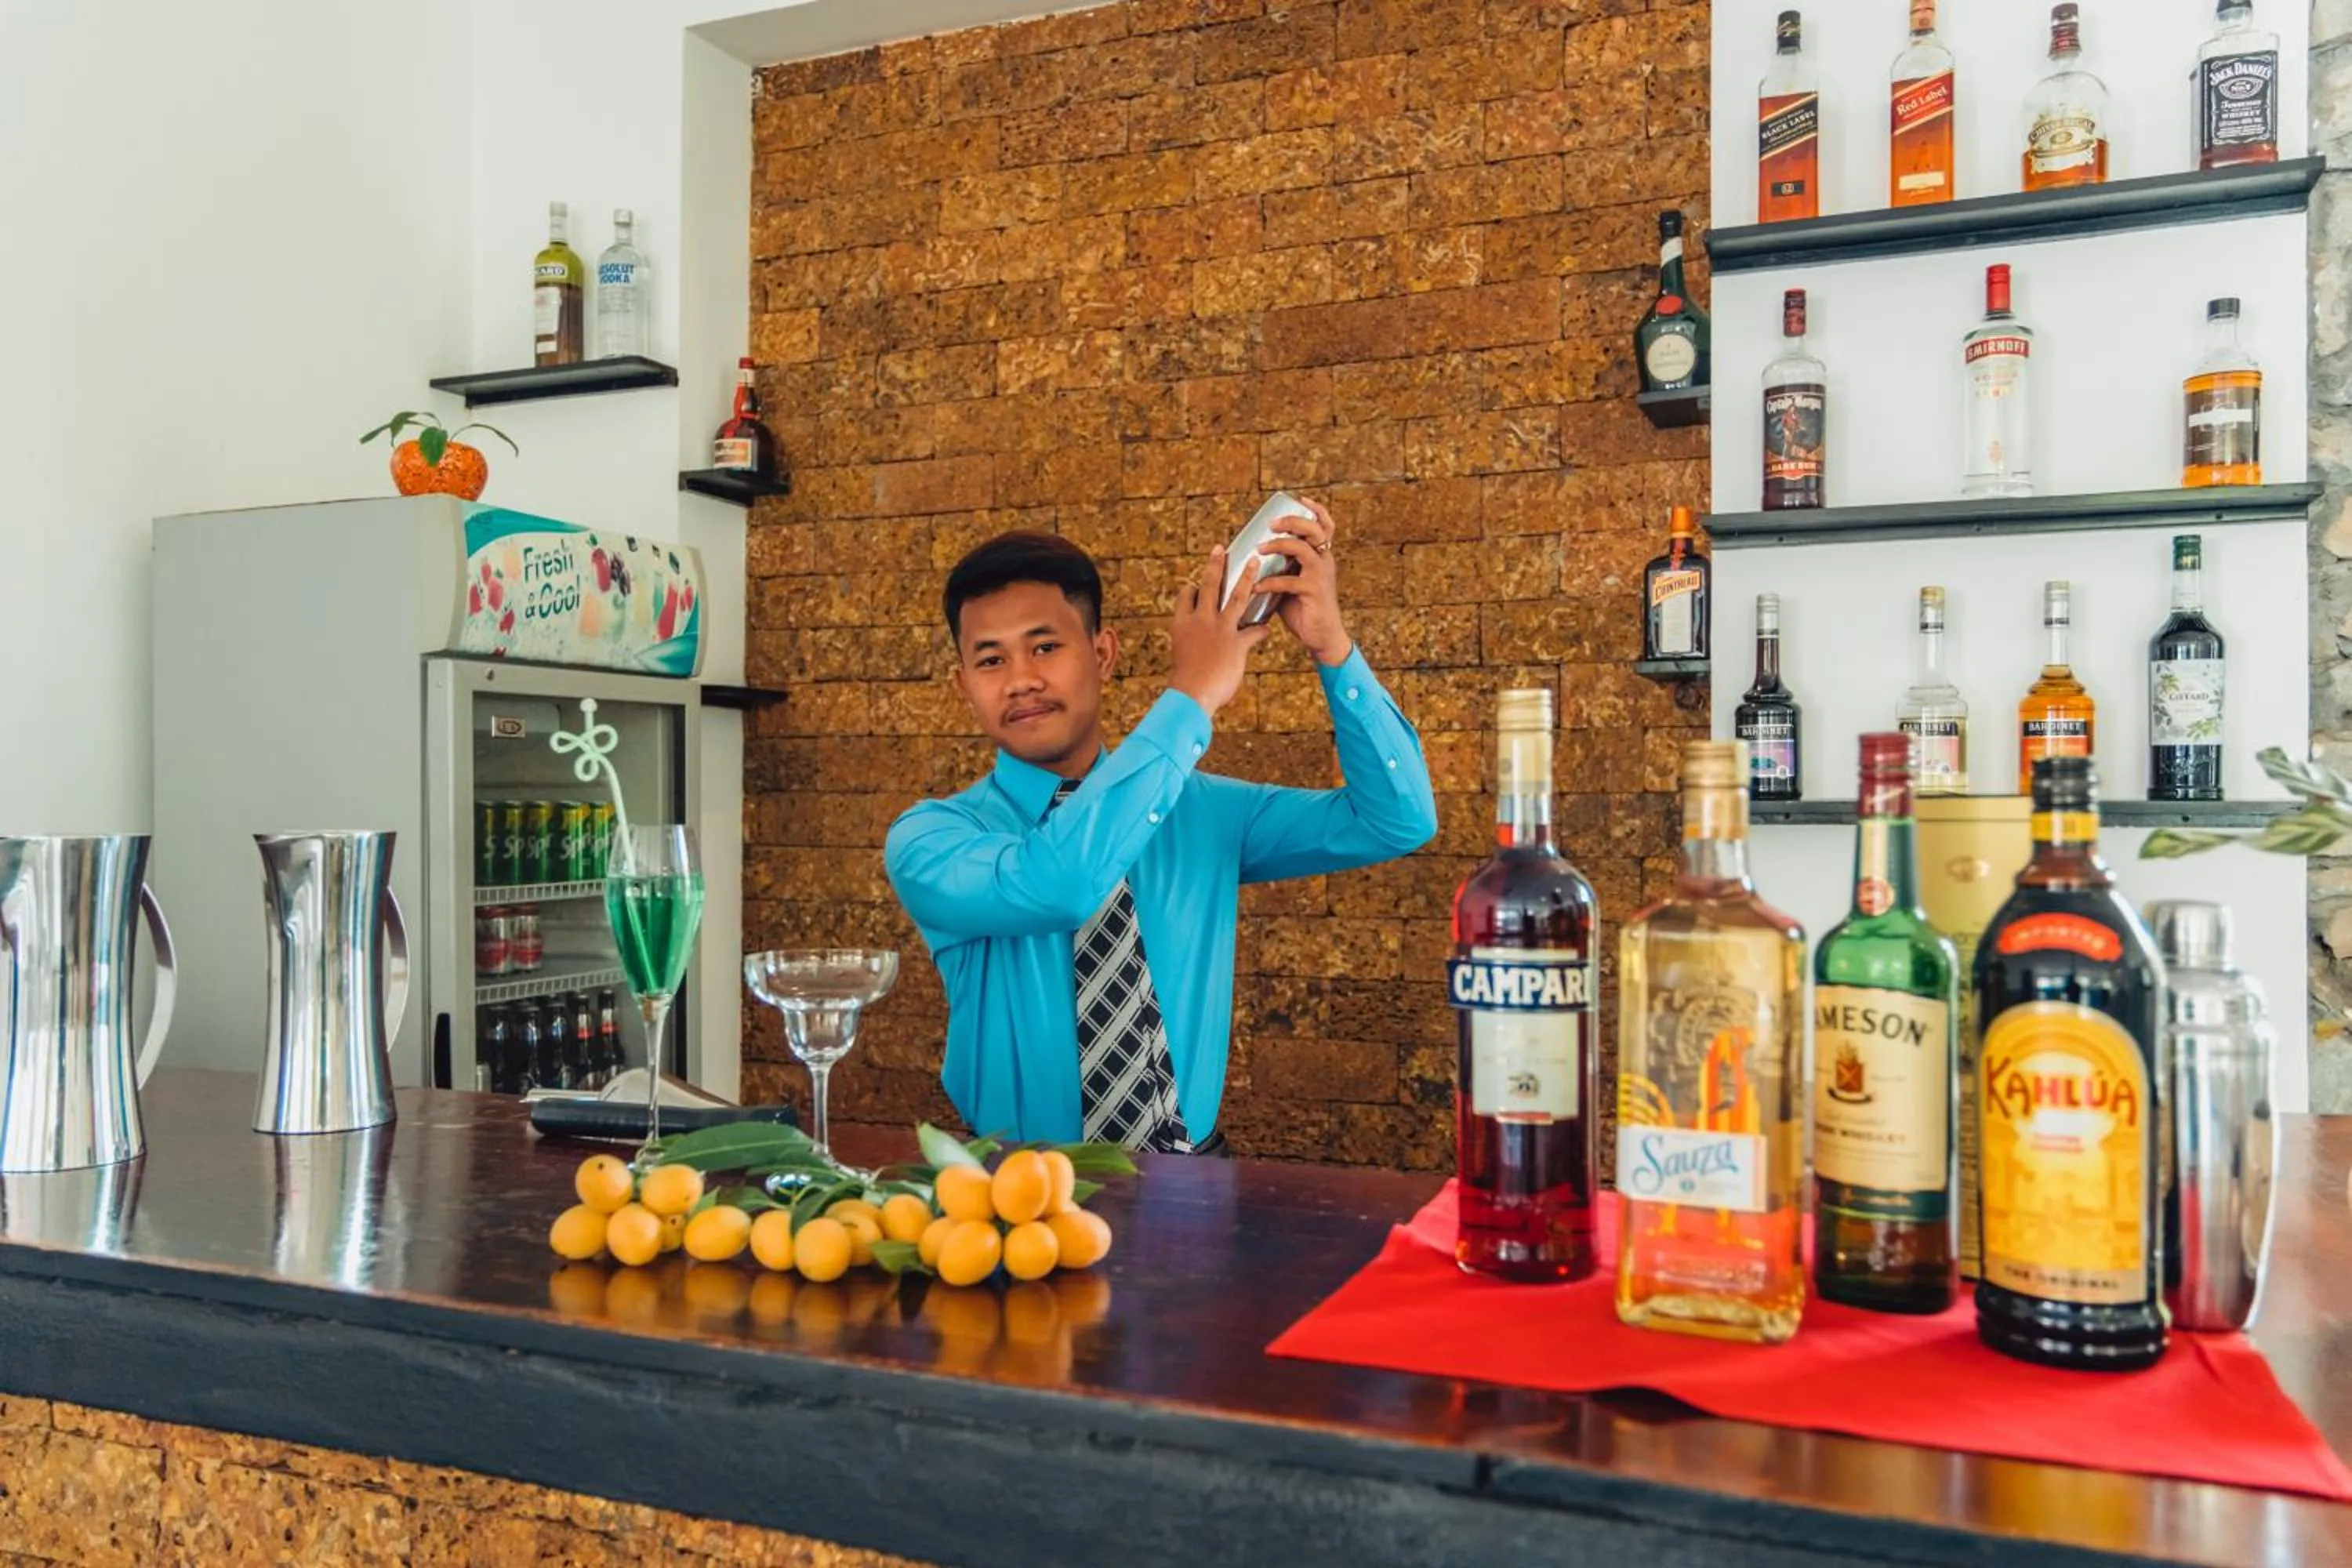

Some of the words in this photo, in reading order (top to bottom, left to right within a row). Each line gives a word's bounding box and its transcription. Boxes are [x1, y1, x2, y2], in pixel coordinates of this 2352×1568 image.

[2209, 65, 2234, 85] JACK
[1896, 99, 1918, 116] Red
[1918, 85, 1947, 105] Label
[1761, 123, 1788, 139] BLACK
[1788, 111, 1816, 126] LABEL
[1967, 339, 2026, 360] SMIRNOFF
[523, 539, 574, 583] Fresh
[539, 575, 580, 619] Cool
[1454, 964, 1592, 1005] CAMPARI
[1815, 1005, 1926, 1046] AMESON
[1985, 1054, 2138, 1128] KAHLÚA
[1632, 1134, 1738, 1195] Sauza
